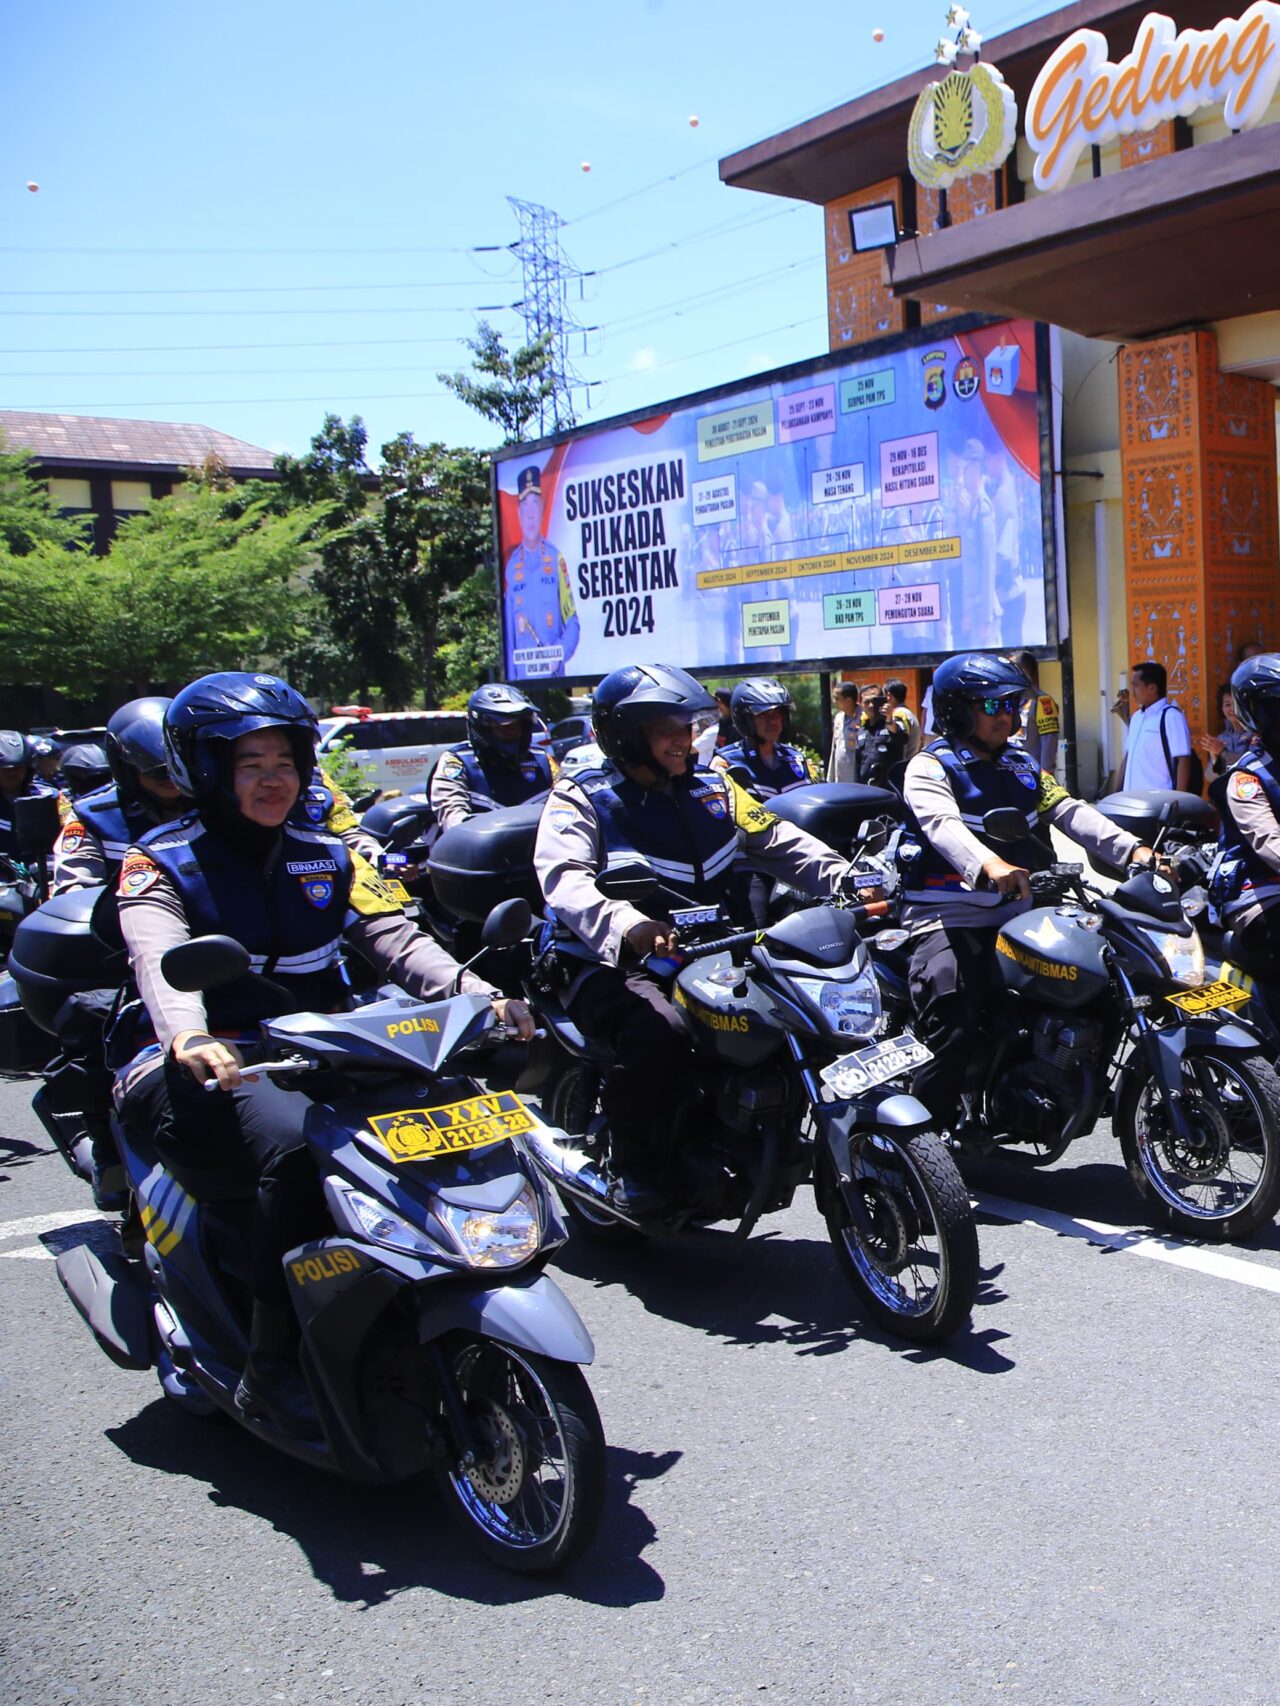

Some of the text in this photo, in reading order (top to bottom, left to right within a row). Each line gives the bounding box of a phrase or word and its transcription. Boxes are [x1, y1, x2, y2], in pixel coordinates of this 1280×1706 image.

[1033, 13, 1275, 179] Gedung
[897, 449, 907, 460] NOV
[918, 446, 927, 457] DES
[566, 459, 684, 521] SUKSESKAN
[824, 483, 854, 497] MASA TENANG
[885, 475, 935, 493] HASIL HITUNG SUARA
[581, 507, 666, 559] PILKADA
[904, 544, 954, 558] DESEMBER 2024
[798, 559, 836, 571] OKTOBER 2024
[846, 552, 894, 565] NOVEMBER 2024
[578, 548, 679, 600] SERENTAK
[746, 566, 787, 578] SEPTEMBER 2024
[852, 598, 862, 608] NOV
[912, 592, 922, 603] NOV
[602, 595, 655, 638] 2024
[856, 612, 864, 622] TPS
[885, 606, 934, 620] PEMUNGUTAN SUARA
[385, 757, 428, 766] AMBULANCE
[291, 861, 333, 872] BINMAS
[819, 942, 844, 951] HONDA
[386, 1017, 439, 1039] POLISI
[444, 1098, 501, 1125] XXV
[447, 1114, 530, 1147] 21235-28
[292, 1250, 360, 1285] POLISI
